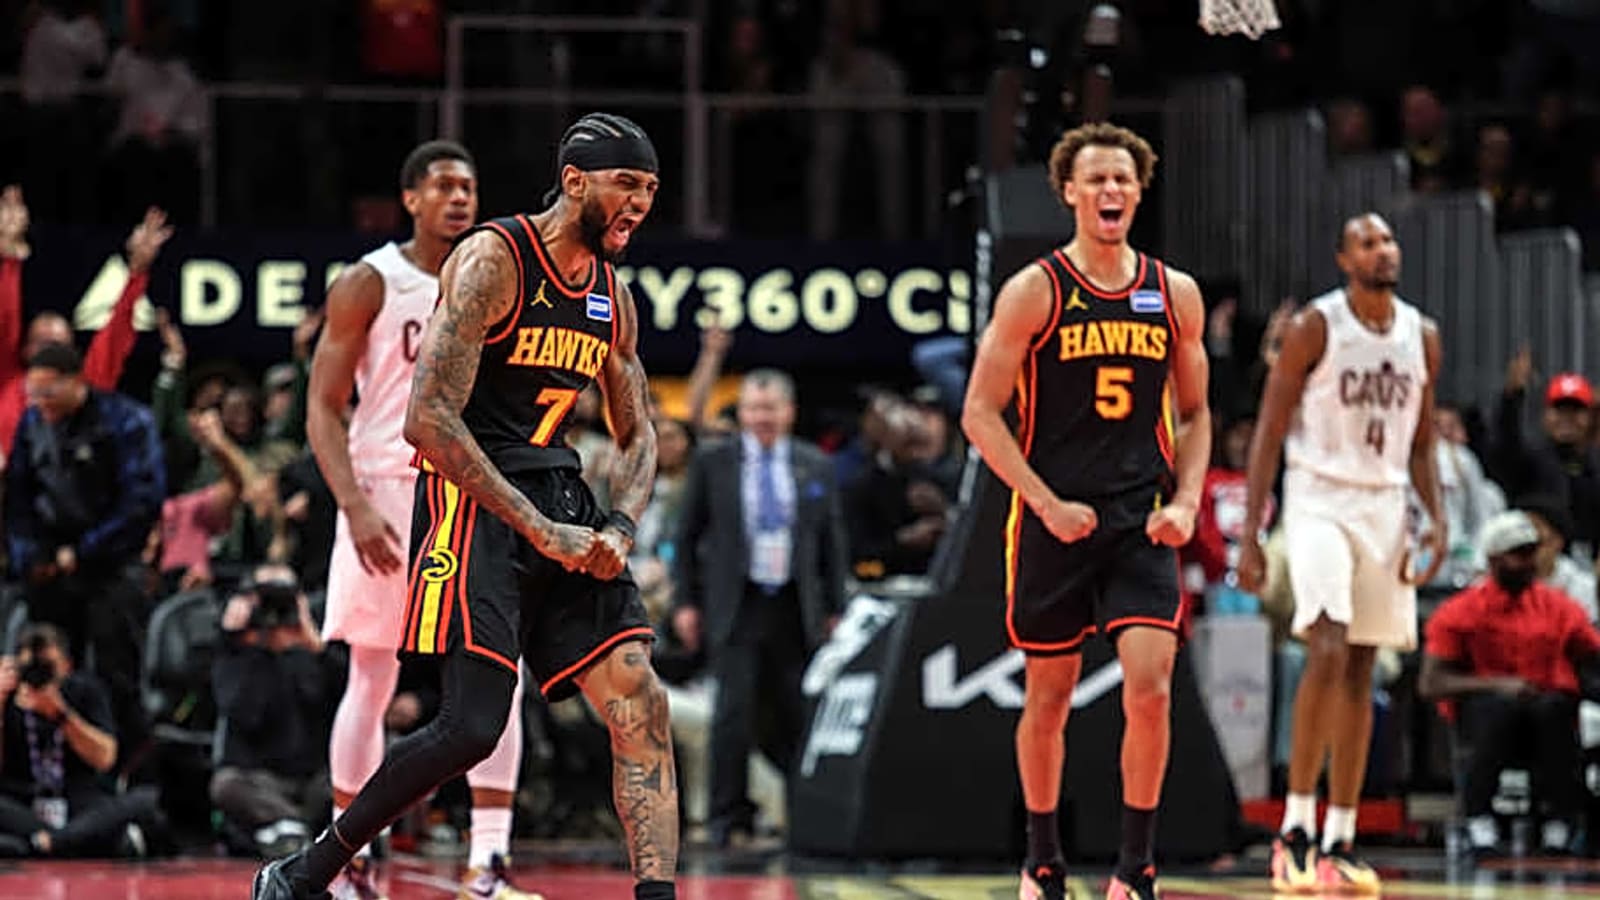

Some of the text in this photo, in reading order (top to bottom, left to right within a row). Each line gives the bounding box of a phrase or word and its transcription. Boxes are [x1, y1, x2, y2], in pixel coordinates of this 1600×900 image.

[506, 326, 610, 380] HAWKS
[1057, 320, 1169, 363] HAWKS
[1095, 366, 1135, 420] 5
[1339, 360, 1412, 411] CAVS
[529, 387, 579, 448] 7
[1366, 417, 1385, 457] 4
